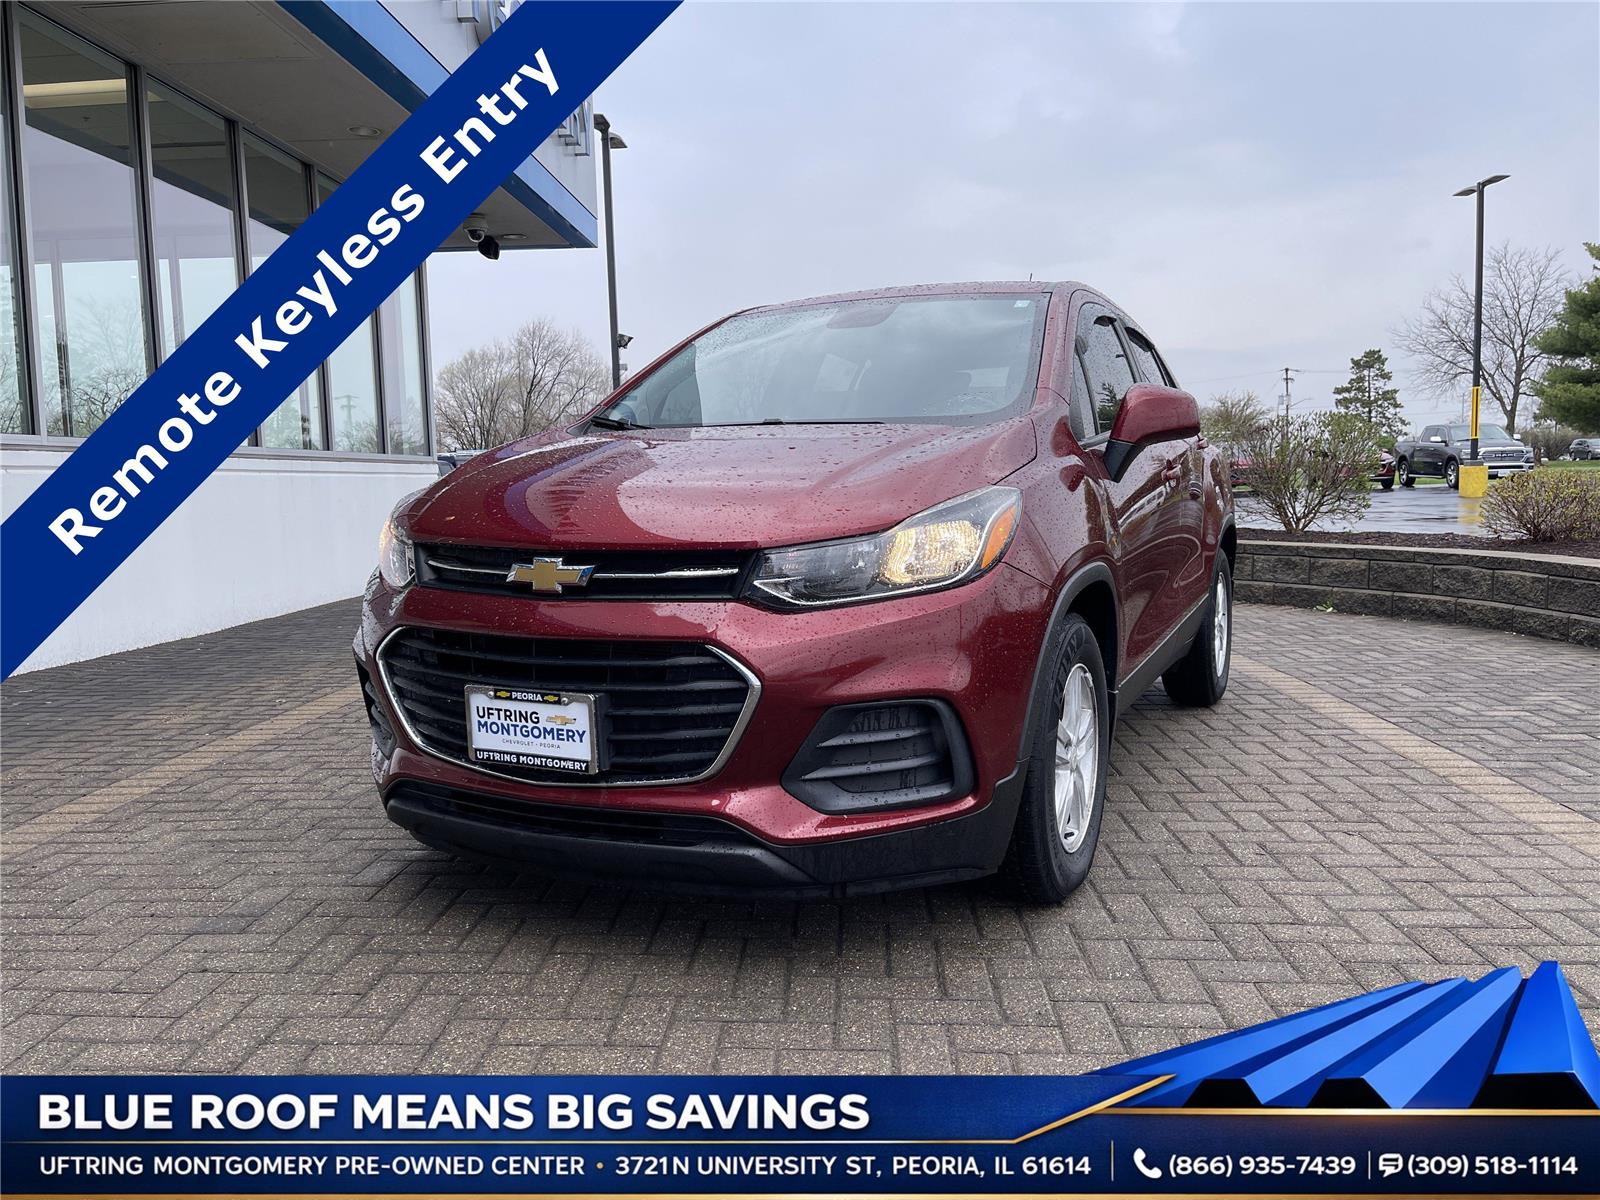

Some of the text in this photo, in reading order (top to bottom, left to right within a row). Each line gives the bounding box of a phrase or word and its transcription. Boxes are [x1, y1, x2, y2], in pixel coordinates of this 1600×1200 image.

[511, 691, 543, 702] PEORIA
[476, 705, 540, 724] UFTRING
[477, 720, 587, 743] MONTGOMERY
[502, 738, 534, 747] CHEVROLET
[476, 751, 587, 771] UFTRING MONTGOMERY
